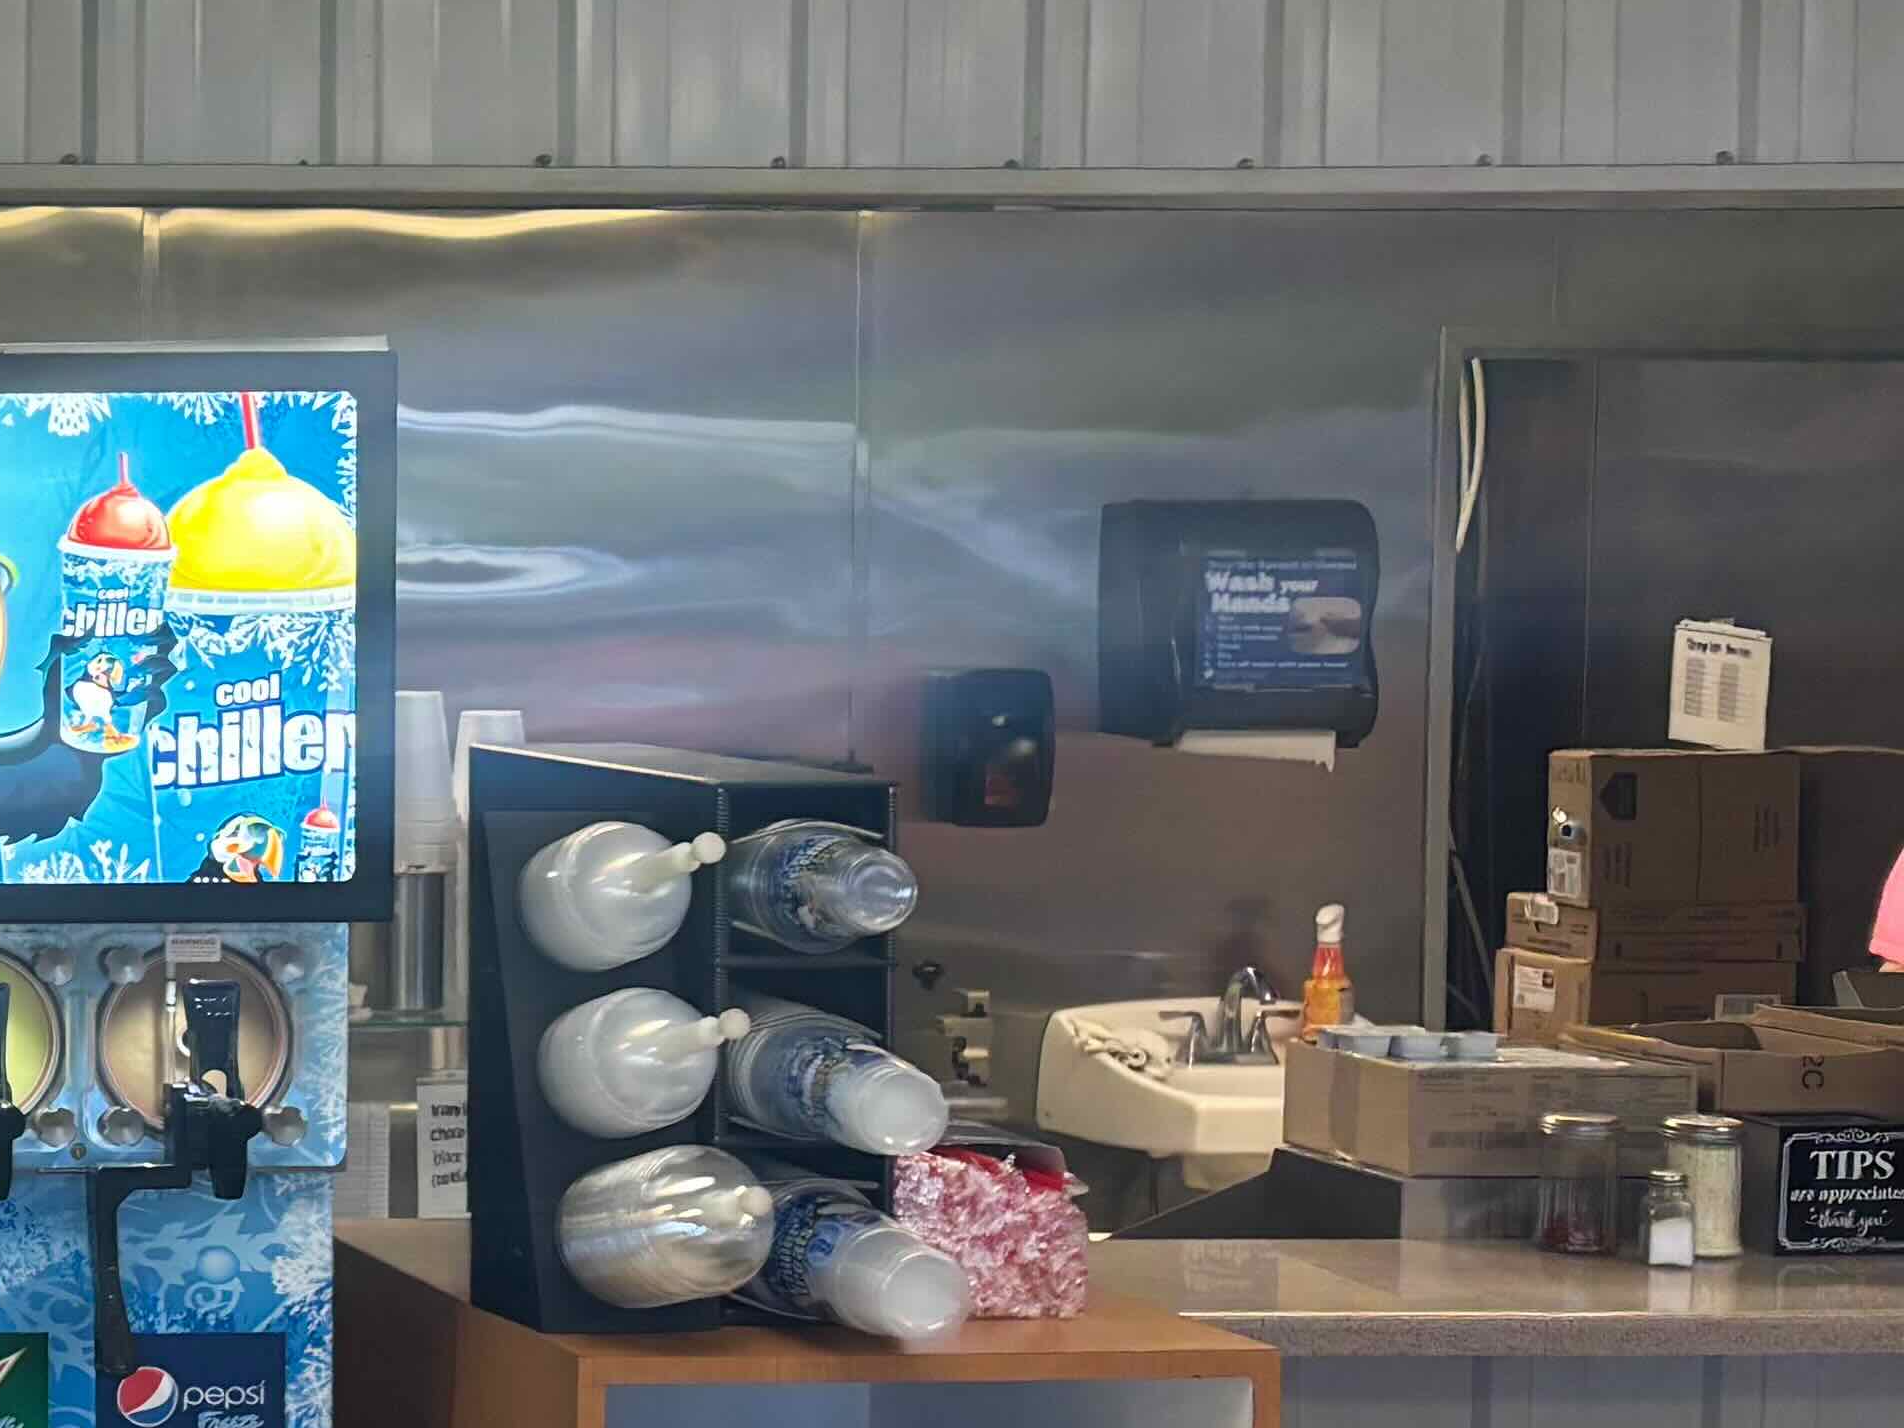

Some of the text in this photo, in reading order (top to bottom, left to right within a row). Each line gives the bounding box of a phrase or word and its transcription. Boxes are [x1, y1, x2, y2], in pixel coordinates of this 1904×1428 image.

[97, 587, 129, 600] cool
[1205, 571, 1319, 594] Wash your
[1211, 593, 1291, 613] Hands
[216, 673, 280, 706] cool
[151, 704, 356, 788] chiller
[1810, 1150, 1895, 1180] TIPS
[1790, 1186, 1904, 1204] are appreciate
[183, 1380, 265, 1411] pepsi
